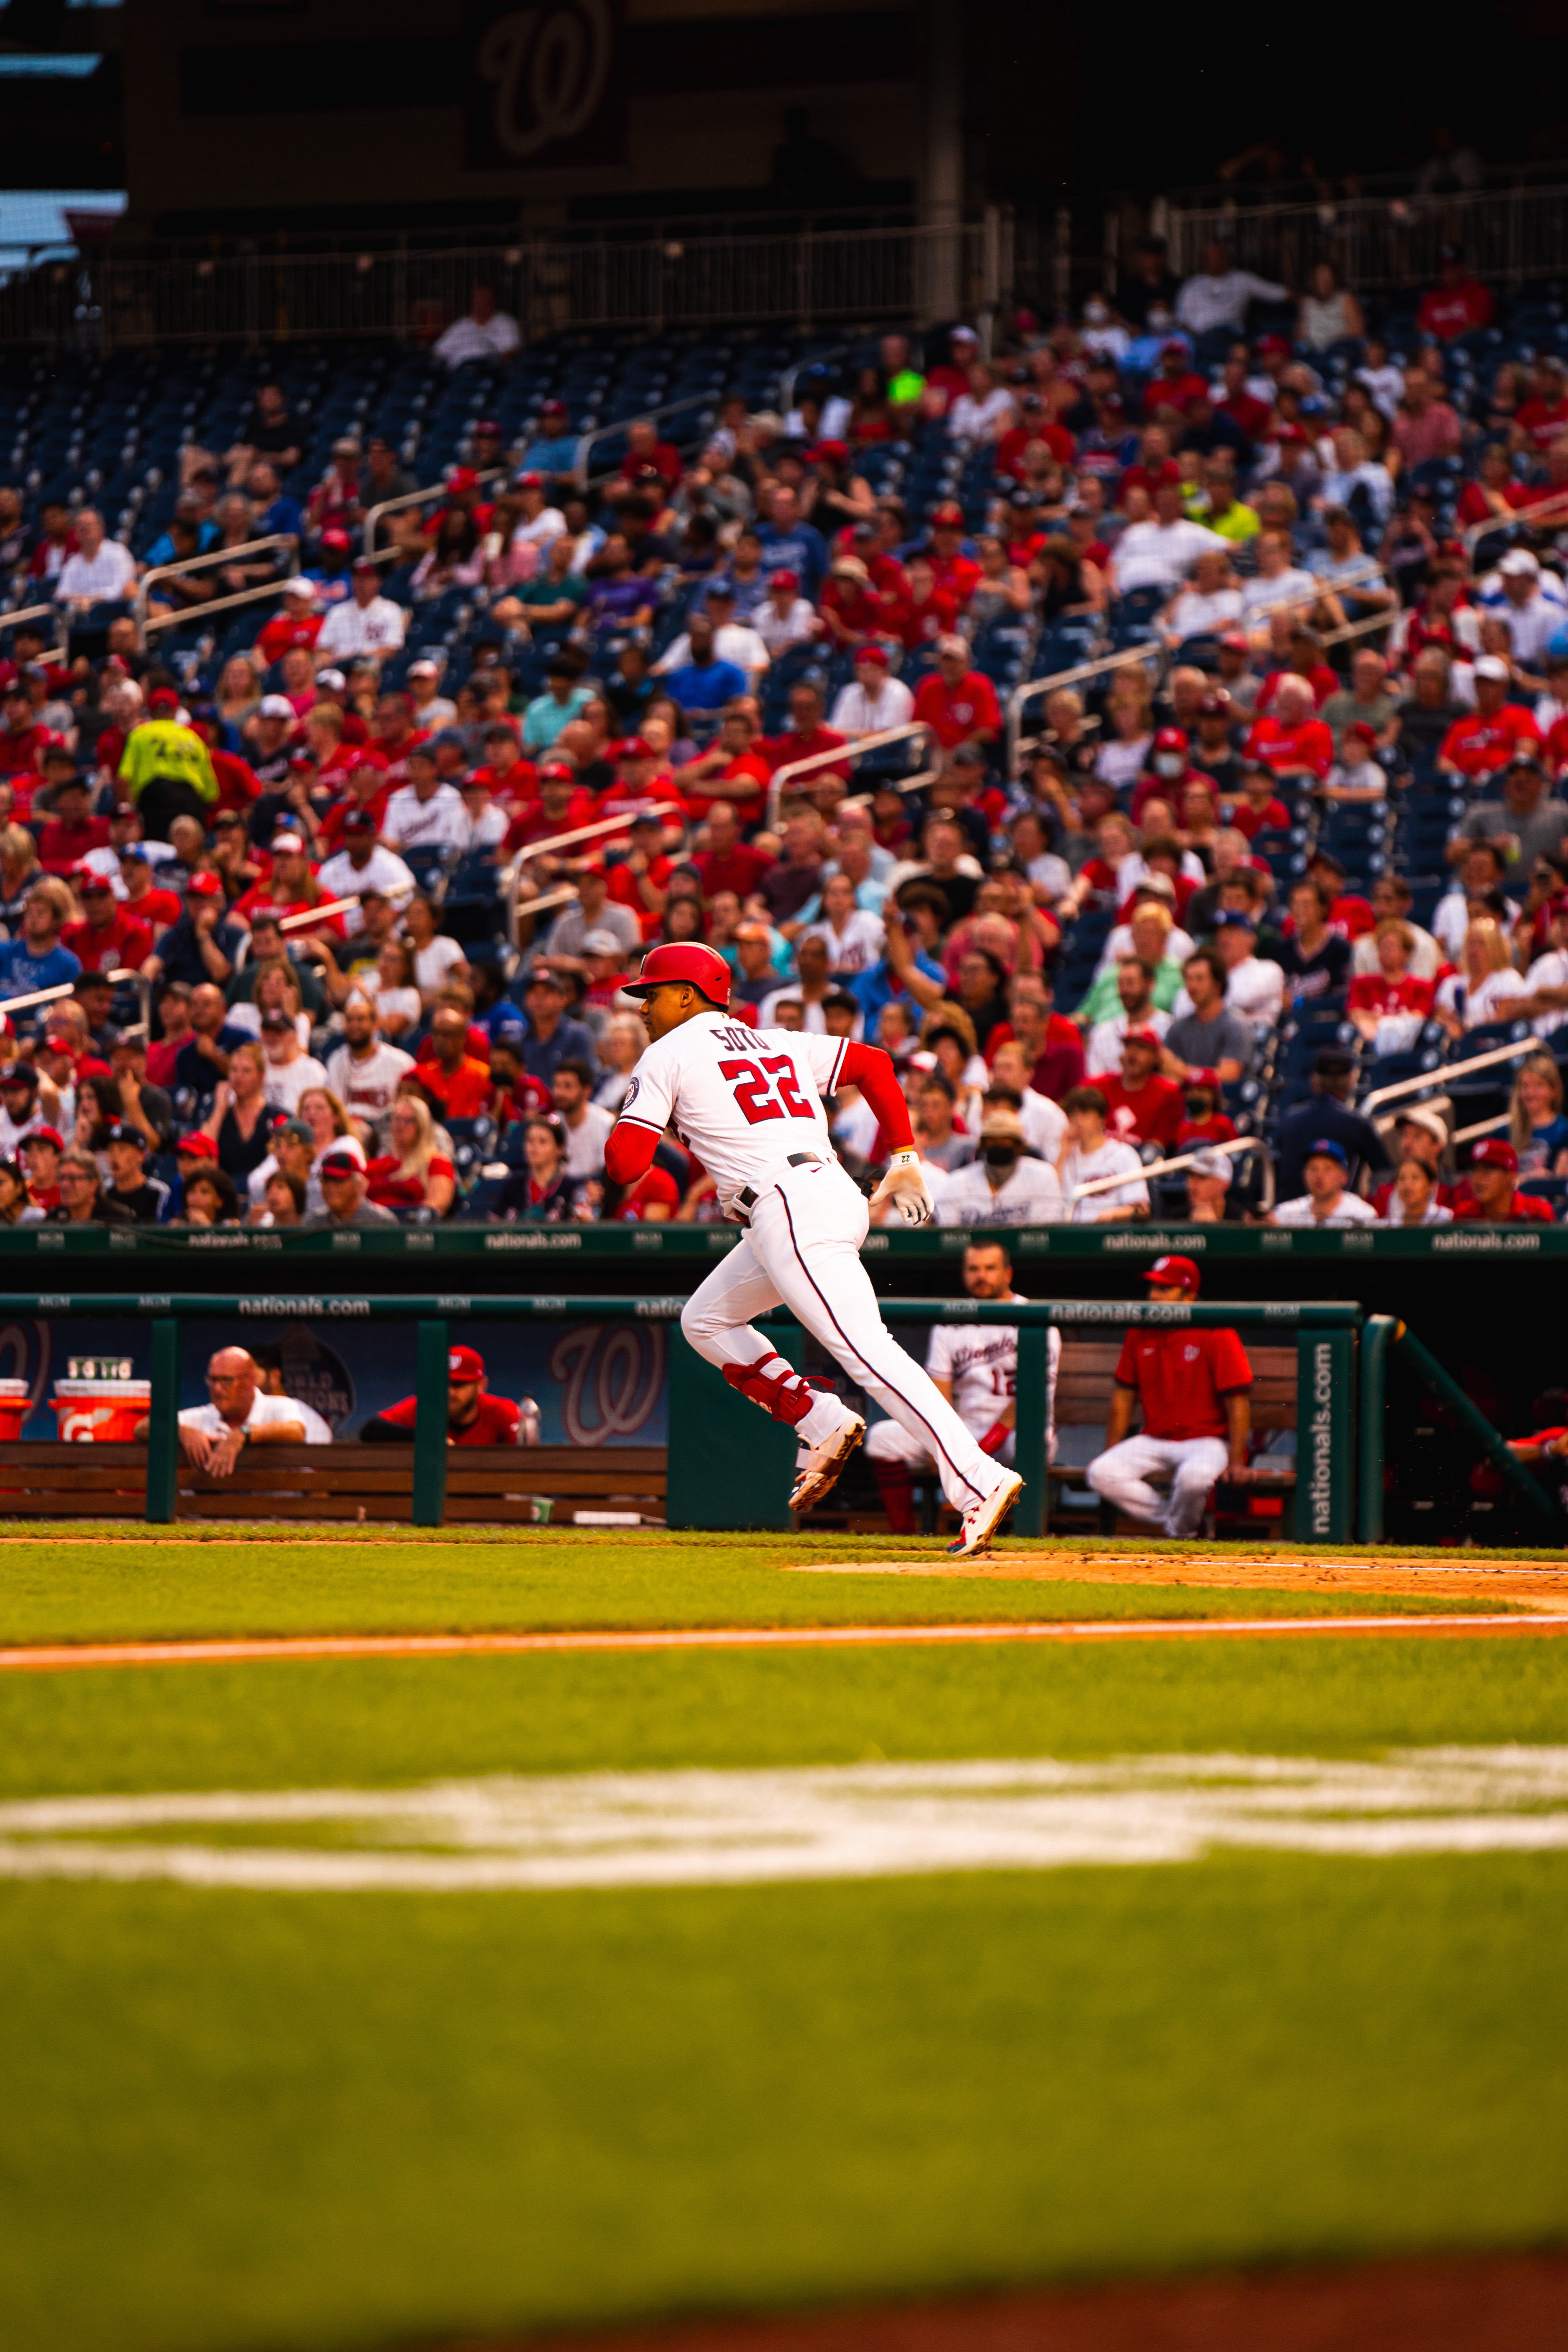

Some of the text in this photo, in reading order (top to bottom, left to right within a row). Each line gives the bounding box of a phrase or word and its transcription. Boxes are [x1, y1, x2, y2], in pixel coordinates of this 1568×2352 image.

[709, 1027, 771, 1051] SOTO
[718, 1054, 816, 1125] 22
[485, 1230, 581, 1250] nationals.com
[1102, 1230, 1206, 1251] nationals.com
[1432, 1230, 1539, 1251] nationals.com
[238, 1296, 370, 1316] nationals.com
[1048, 1302, 1191, 1322] nationals.com
[1309, 1343, 1332, 1535] nationals.com
